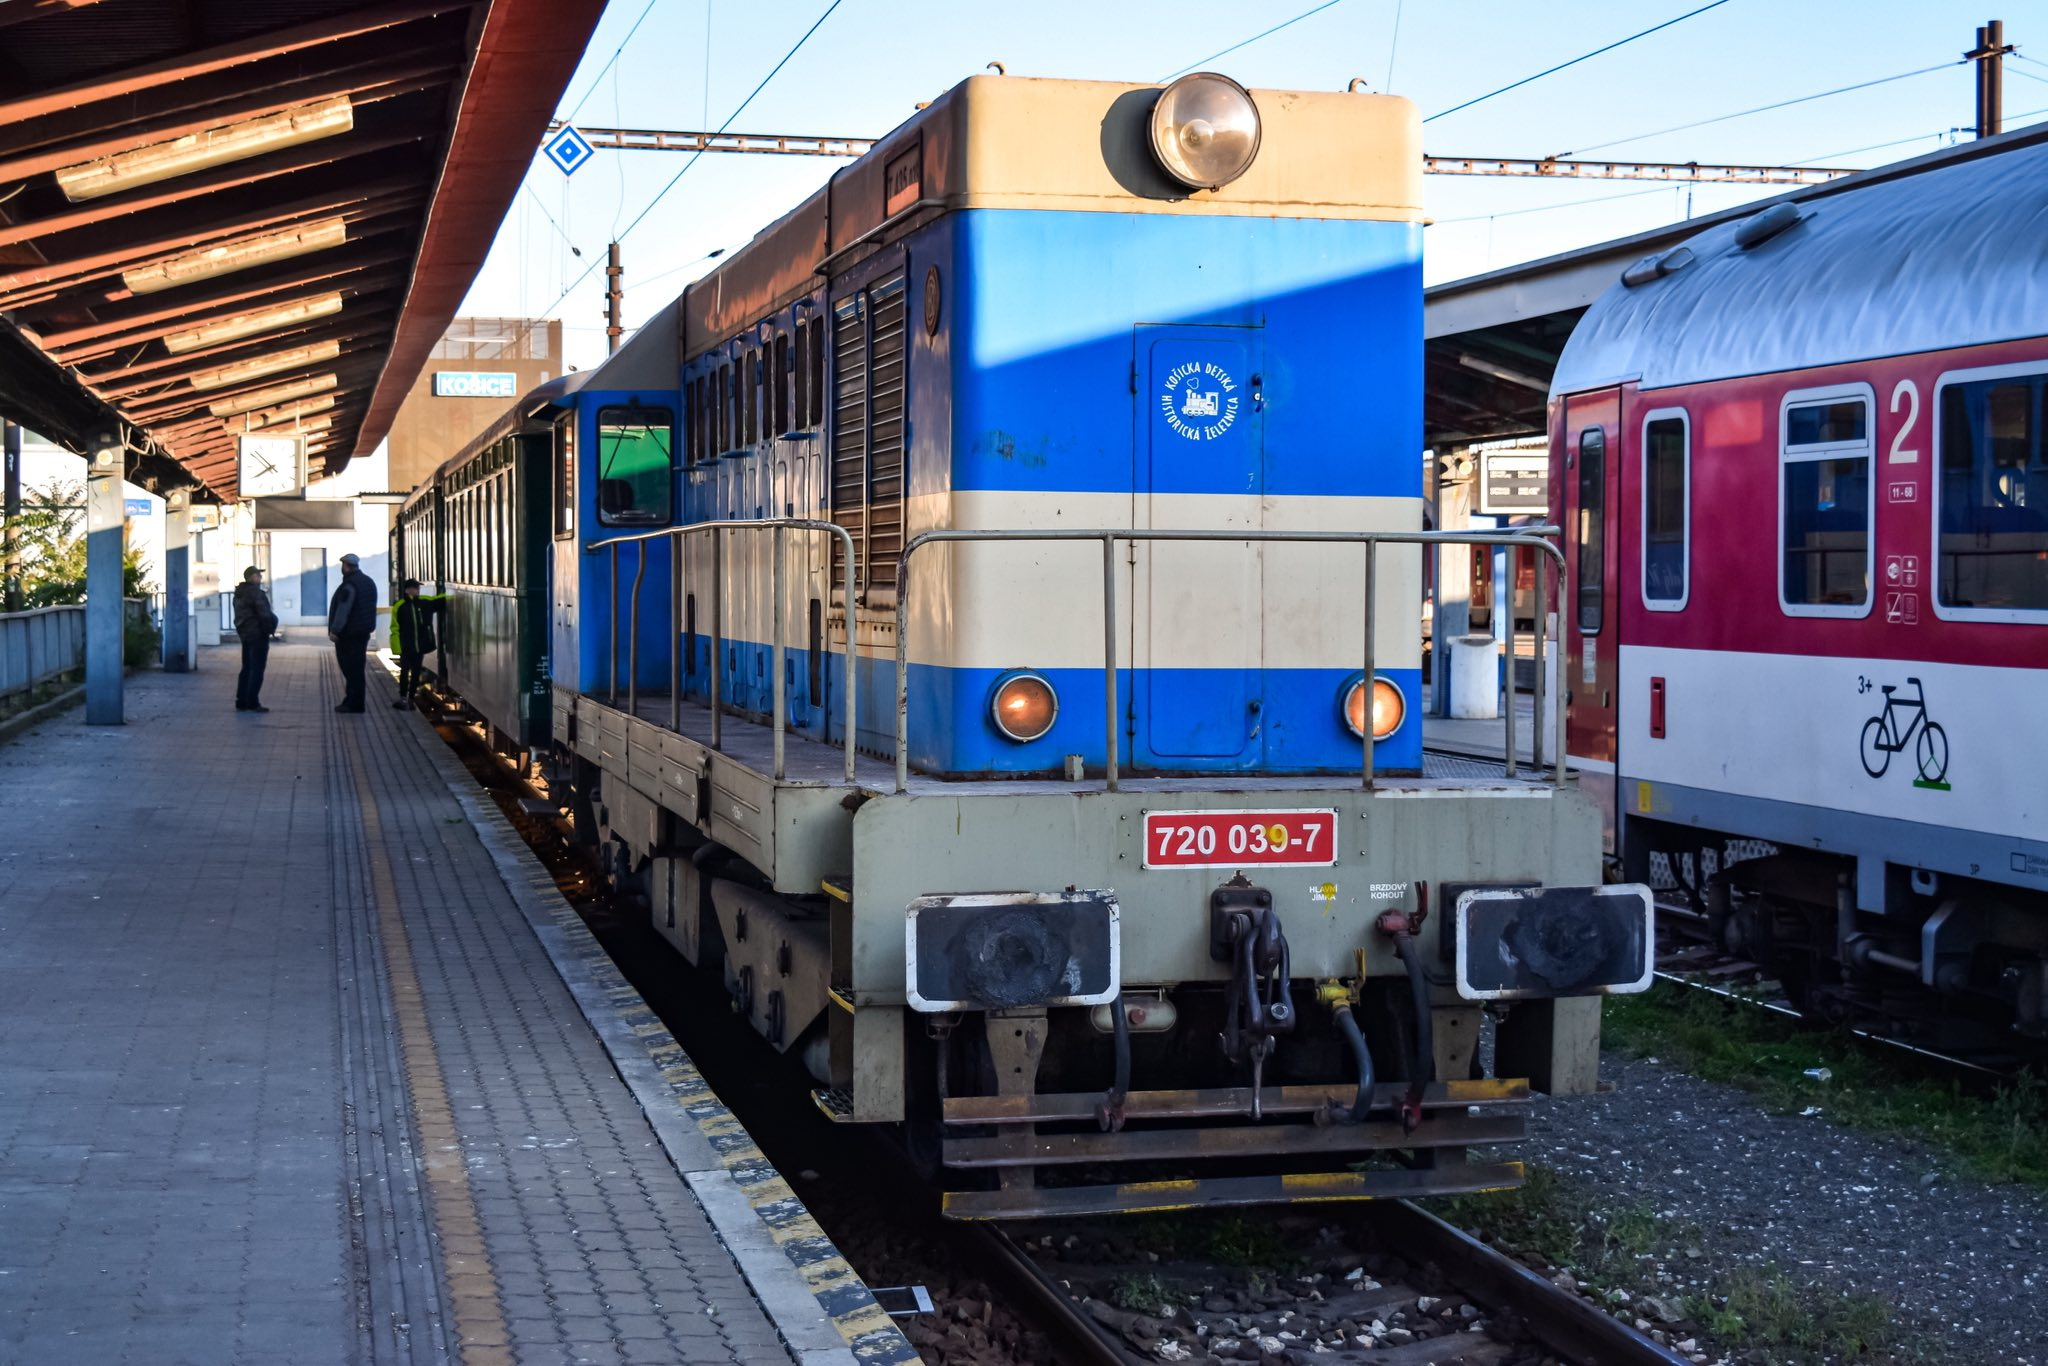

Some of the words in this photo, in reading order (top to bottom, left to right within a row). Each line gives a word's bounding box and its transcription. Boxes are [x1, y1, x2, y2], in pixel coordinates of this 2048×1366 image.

[1205, 362, 1238, 393] DETSKÁ
[1161, 395, 1200, 441] HISTORICKÁ
[1204, 397, 1239, 441] ŽELEZNICA
[1888, 379, 1919, 464] 2
[1155, 825, 1216, 856] 720
[1228, 823, 1322, 854] 039-7
[1369, 882, 1408, 892] BRZDOVÝ
[1370, 891, 1405, 900] KOHOUT
